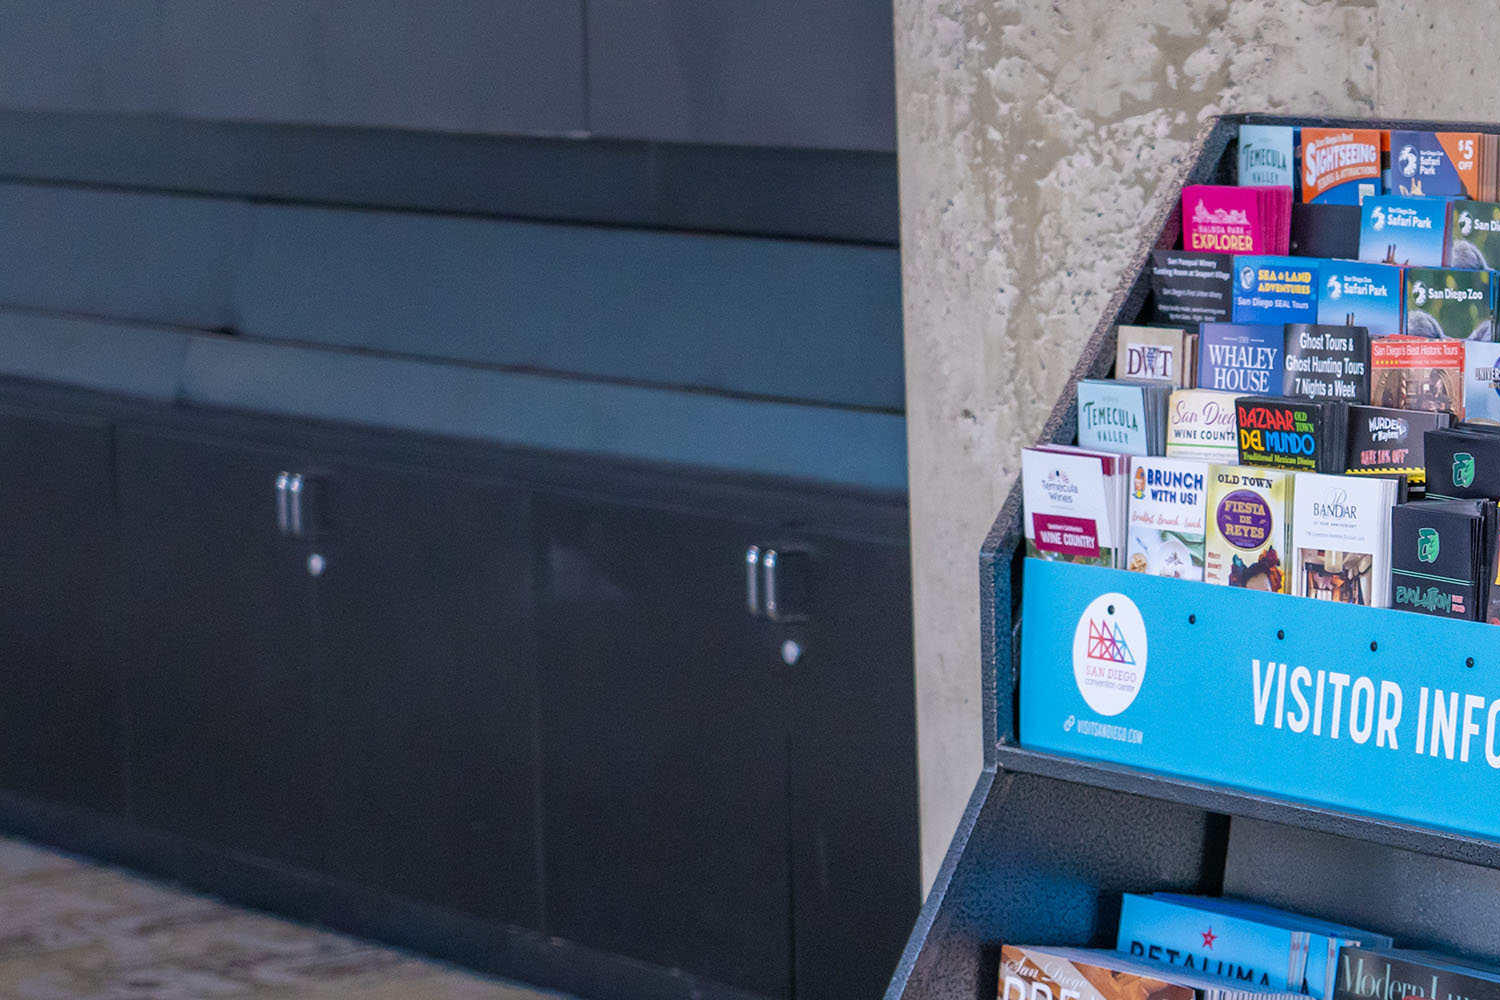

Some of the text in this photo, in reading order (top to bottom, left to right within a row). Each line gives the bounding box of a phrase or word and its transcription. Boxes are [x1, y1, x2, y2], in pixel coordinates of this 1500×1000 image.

[1305, 142, 1377, 187] SIGHTSEEING
[1388, 215, 1432, 230] Safari Park
[1474, 218, 1490, 229] San
[1192, 233, 1253, 252] EXPLORER
[1258, 282, 1310, 296] ADVENTURES
[1238, 297, 1310, 310] San Diego SEAL Tours
[1209, 344, 1278, 371] WHALEY
[1374, 344, 1458, 360] San Diego's Best Historic Tours
[1286, 355, 1364, 378] Ghost Hunting Tours
[1214, 368, 1270, 394] HOUSE
[1084, 402, 1138, 432] TEMECULA
[1239, 406, 1296, 432] BAZAAR
[1098, 430, 1129, 446] VALLEY
[1240, 430, 1316, 456] DEL MUNDO
[1042, 480, 1079, 496] Temecula
[1148, 468, 1203, 492] BRUNCH
[1218, 474, 1273, 490] OLD TOWN
[1048, 490, 1073, 505] Wines
[1151, 488, 1197, 506] WITH US!
[1224, 500, 1266, 516] FIESTA
[1314, 502, 1357, 520] BANDAR
[1239, 516, 1252, 525] DE
[1040, 531, 1096, 550] WINE COUNTRY
[1225, 524, 1265, 540] REYES
[1086, 666, 1137, 684] SAN DIEGO
[1085, 678, 1136, 693] convention center
[1252, 659, 1403, 750] VISITOR
[1077, 720, 1144, 744] VISITSANDIEGO.COM
